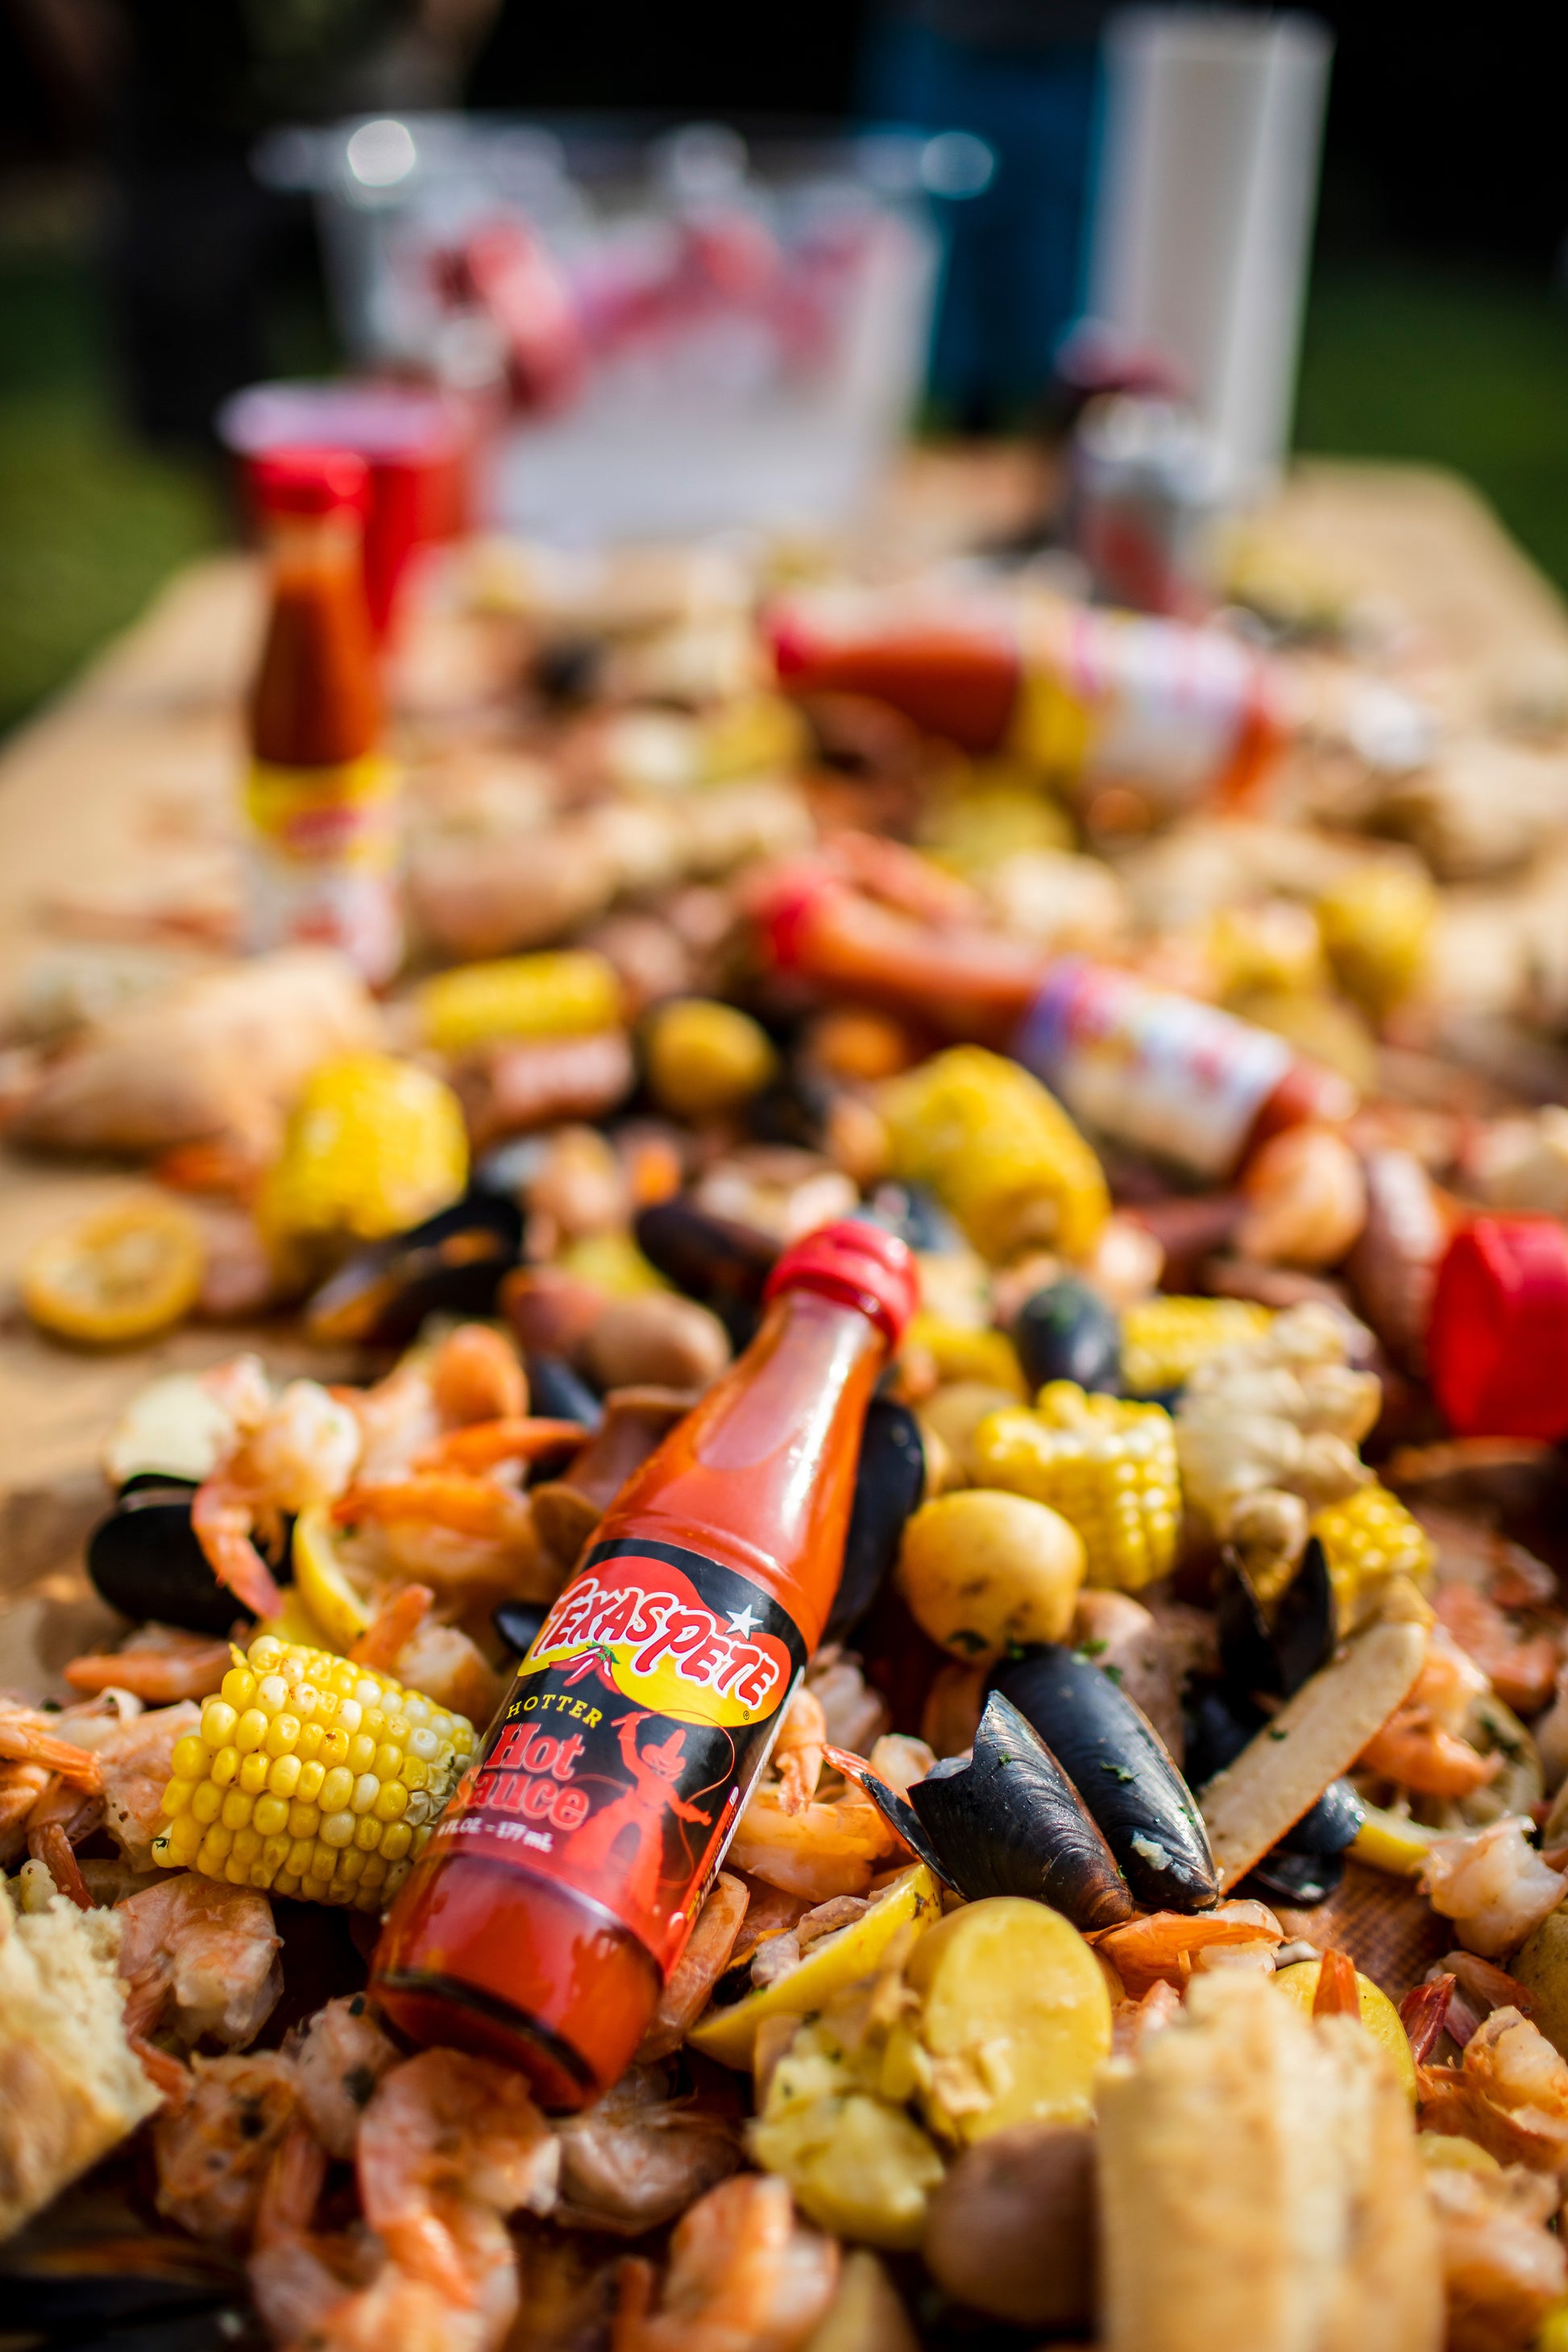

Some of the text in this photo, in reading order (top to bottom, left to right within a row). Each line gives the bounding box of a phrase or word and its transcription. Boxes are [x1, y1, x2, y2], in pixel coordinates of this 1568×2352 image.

[529, 1578, 780, 1710] TEXAS PETE
[506, 1694, 604, 1728] HOTTER
[483, 1722, 586, 1782] Hot
[444, 1764, 590, 1831] Sauce
[702, 1836, 724, 1885] MEDIUM
